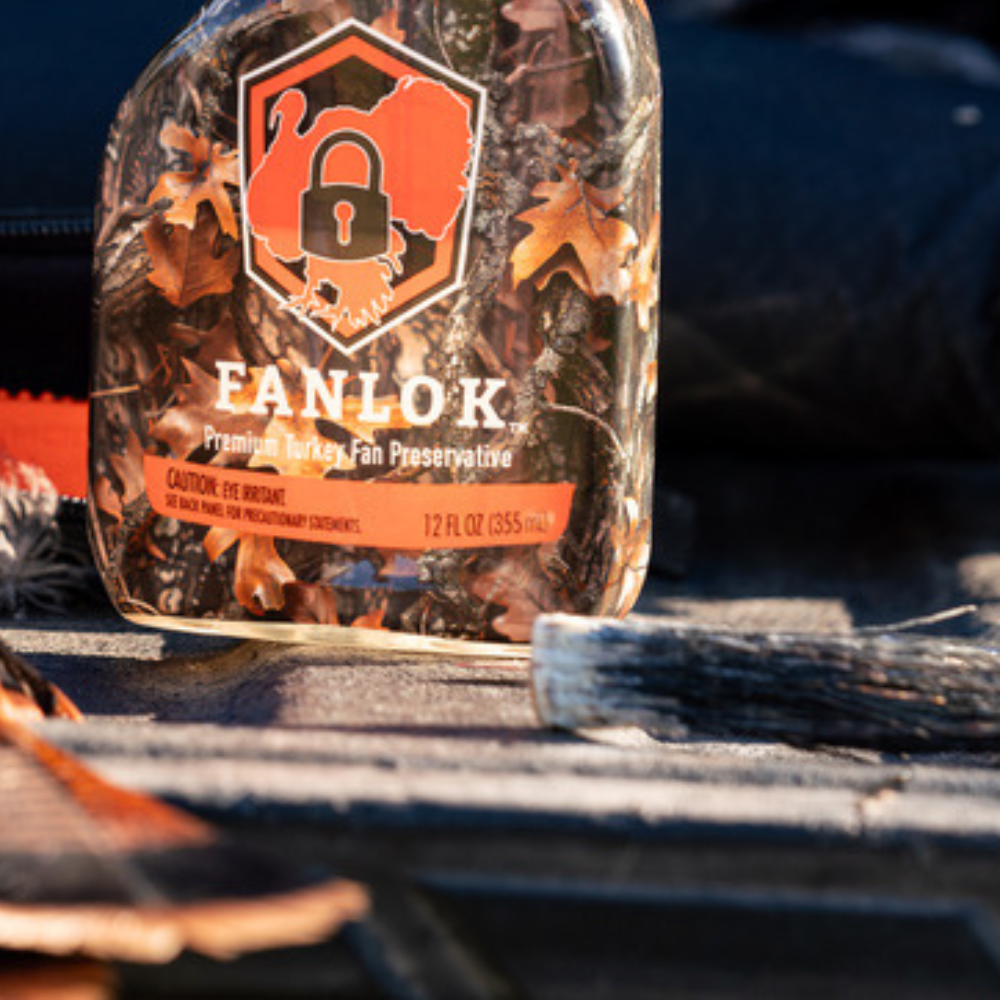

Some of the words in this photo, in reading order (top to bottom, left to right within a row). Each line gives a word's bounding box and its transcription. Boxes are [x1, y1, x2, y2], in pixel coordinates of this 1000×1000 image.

[214, 360, 507, 429] FANLOK
[203, 424, 279, 456] Premium
[285, 433, 346, 468] Turkey
[351, 438, 384, 466] Fan
[389, 439, 513, 468] Preservative
[167, 467, 219, 496] CAUTION:
[223, 481, 240, 500] EYE
[226, 506, 241, 520] FOR
[424, 513, 443, 538] 12
[446, 513, 461, 537] FL
[464, 513, 485, 537] OZ
[488, 510, 523, 536] (355
